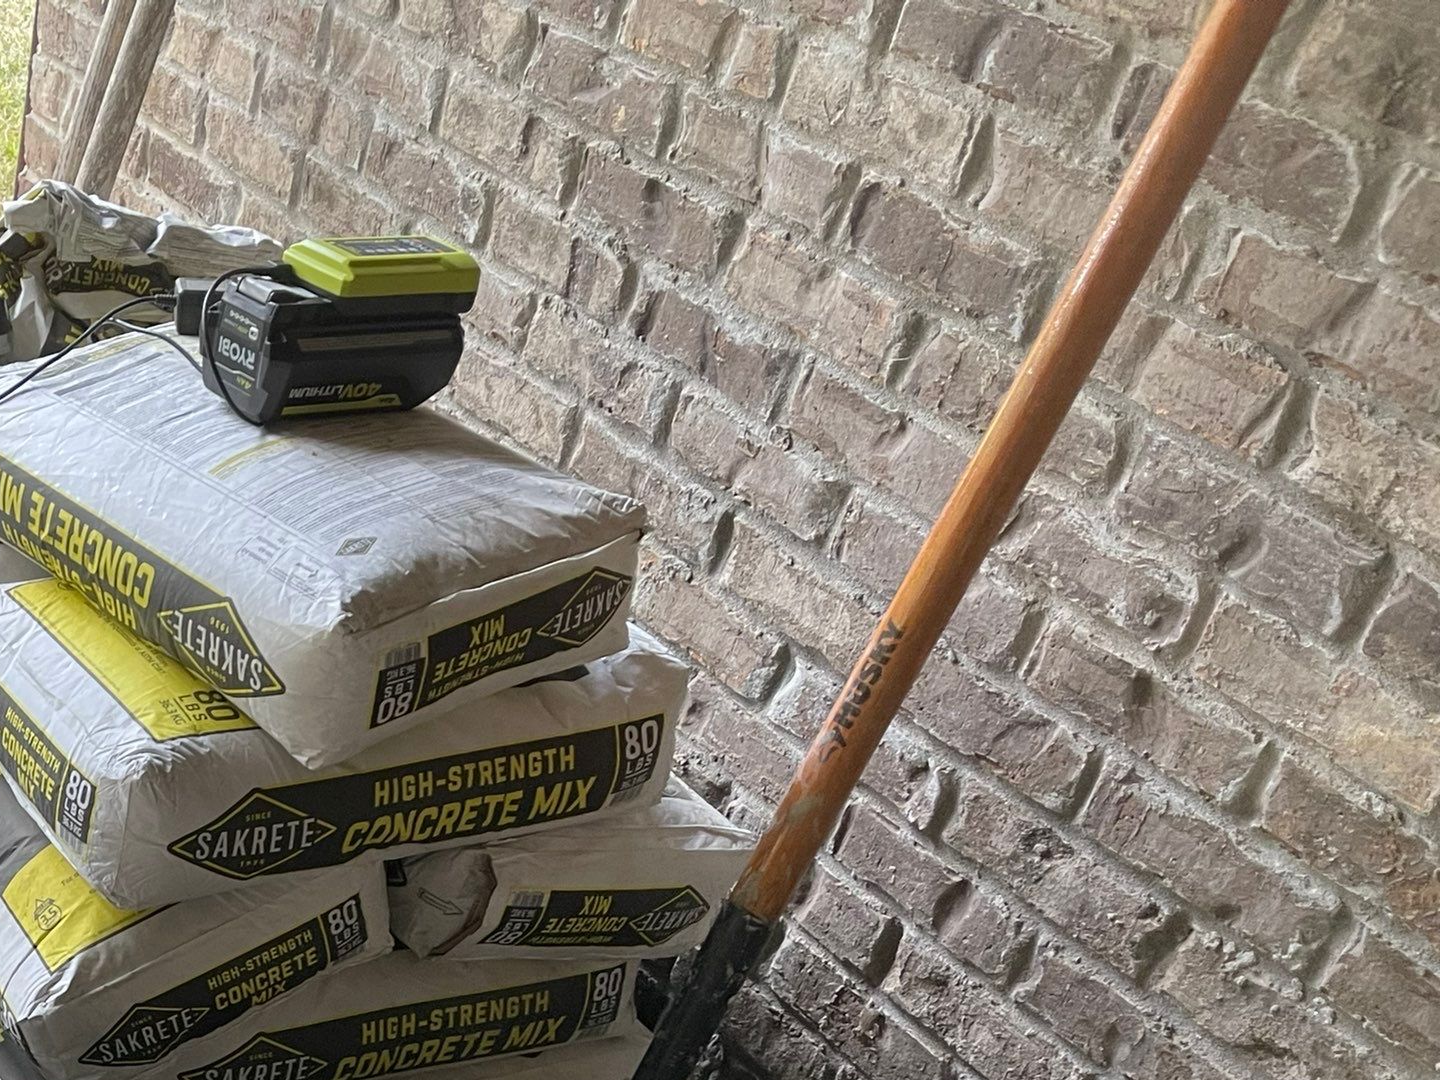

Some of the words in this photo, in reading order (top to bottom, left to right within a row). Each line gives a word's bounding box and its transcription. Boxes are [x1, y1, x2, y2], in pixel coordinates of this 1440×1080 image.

[218, 335, 256, 371] RYOBI
[27, 491, 155, 608] CONCRETE
[550, 580, 628, 637] SAKRETE
[173, 609, 262, 691] SAKRETE
[469, 614, 505, 648] MIX
[432, 627, 532, 683] CONCRETE
[833, 617, 904, 730] HUSKY
[193, 689, 240, 722] 80
[384, 679, 414, 697] LBS
[178, 694, 208, 722] LBS
[376, 691, 413, 724] 80
[5, 707, 61, 773] HIGH-STRENGTH
[624, 719, 658, 760] 80
[1, 729, 56, 801] CONCRETE
[373, 744, 576, 808] HIGH-STRENGTH
[626, 753, 655, 774] LBS
[65, 771, 92, 809] 80
[63, 798, 85, 823] LBS
[245, 811, 272, 823] SINCE
[340, 790, 523, 855] CONCRETE
[529, 775, 599, 821] MIX
[194, 816, 318, 860] SAKRETE
[328, 898, 359, 936] 80
[581, 895, 613, 916] MIX
[334, 923, 361, 945] LBS
[541, 917, 630, 934] CONCRETE
[207, 930, 313, 992] HIGH-STRENGTH
[214, 946, 318, 1011] CONCRETE
[594, 968, 620, 1000] 80
[98, 1008, 194, 1063] SAKRETE
[361, 990, 550, 1046] HIGH-STRENGTH
[503, 1016, 567, 1051] MIX
